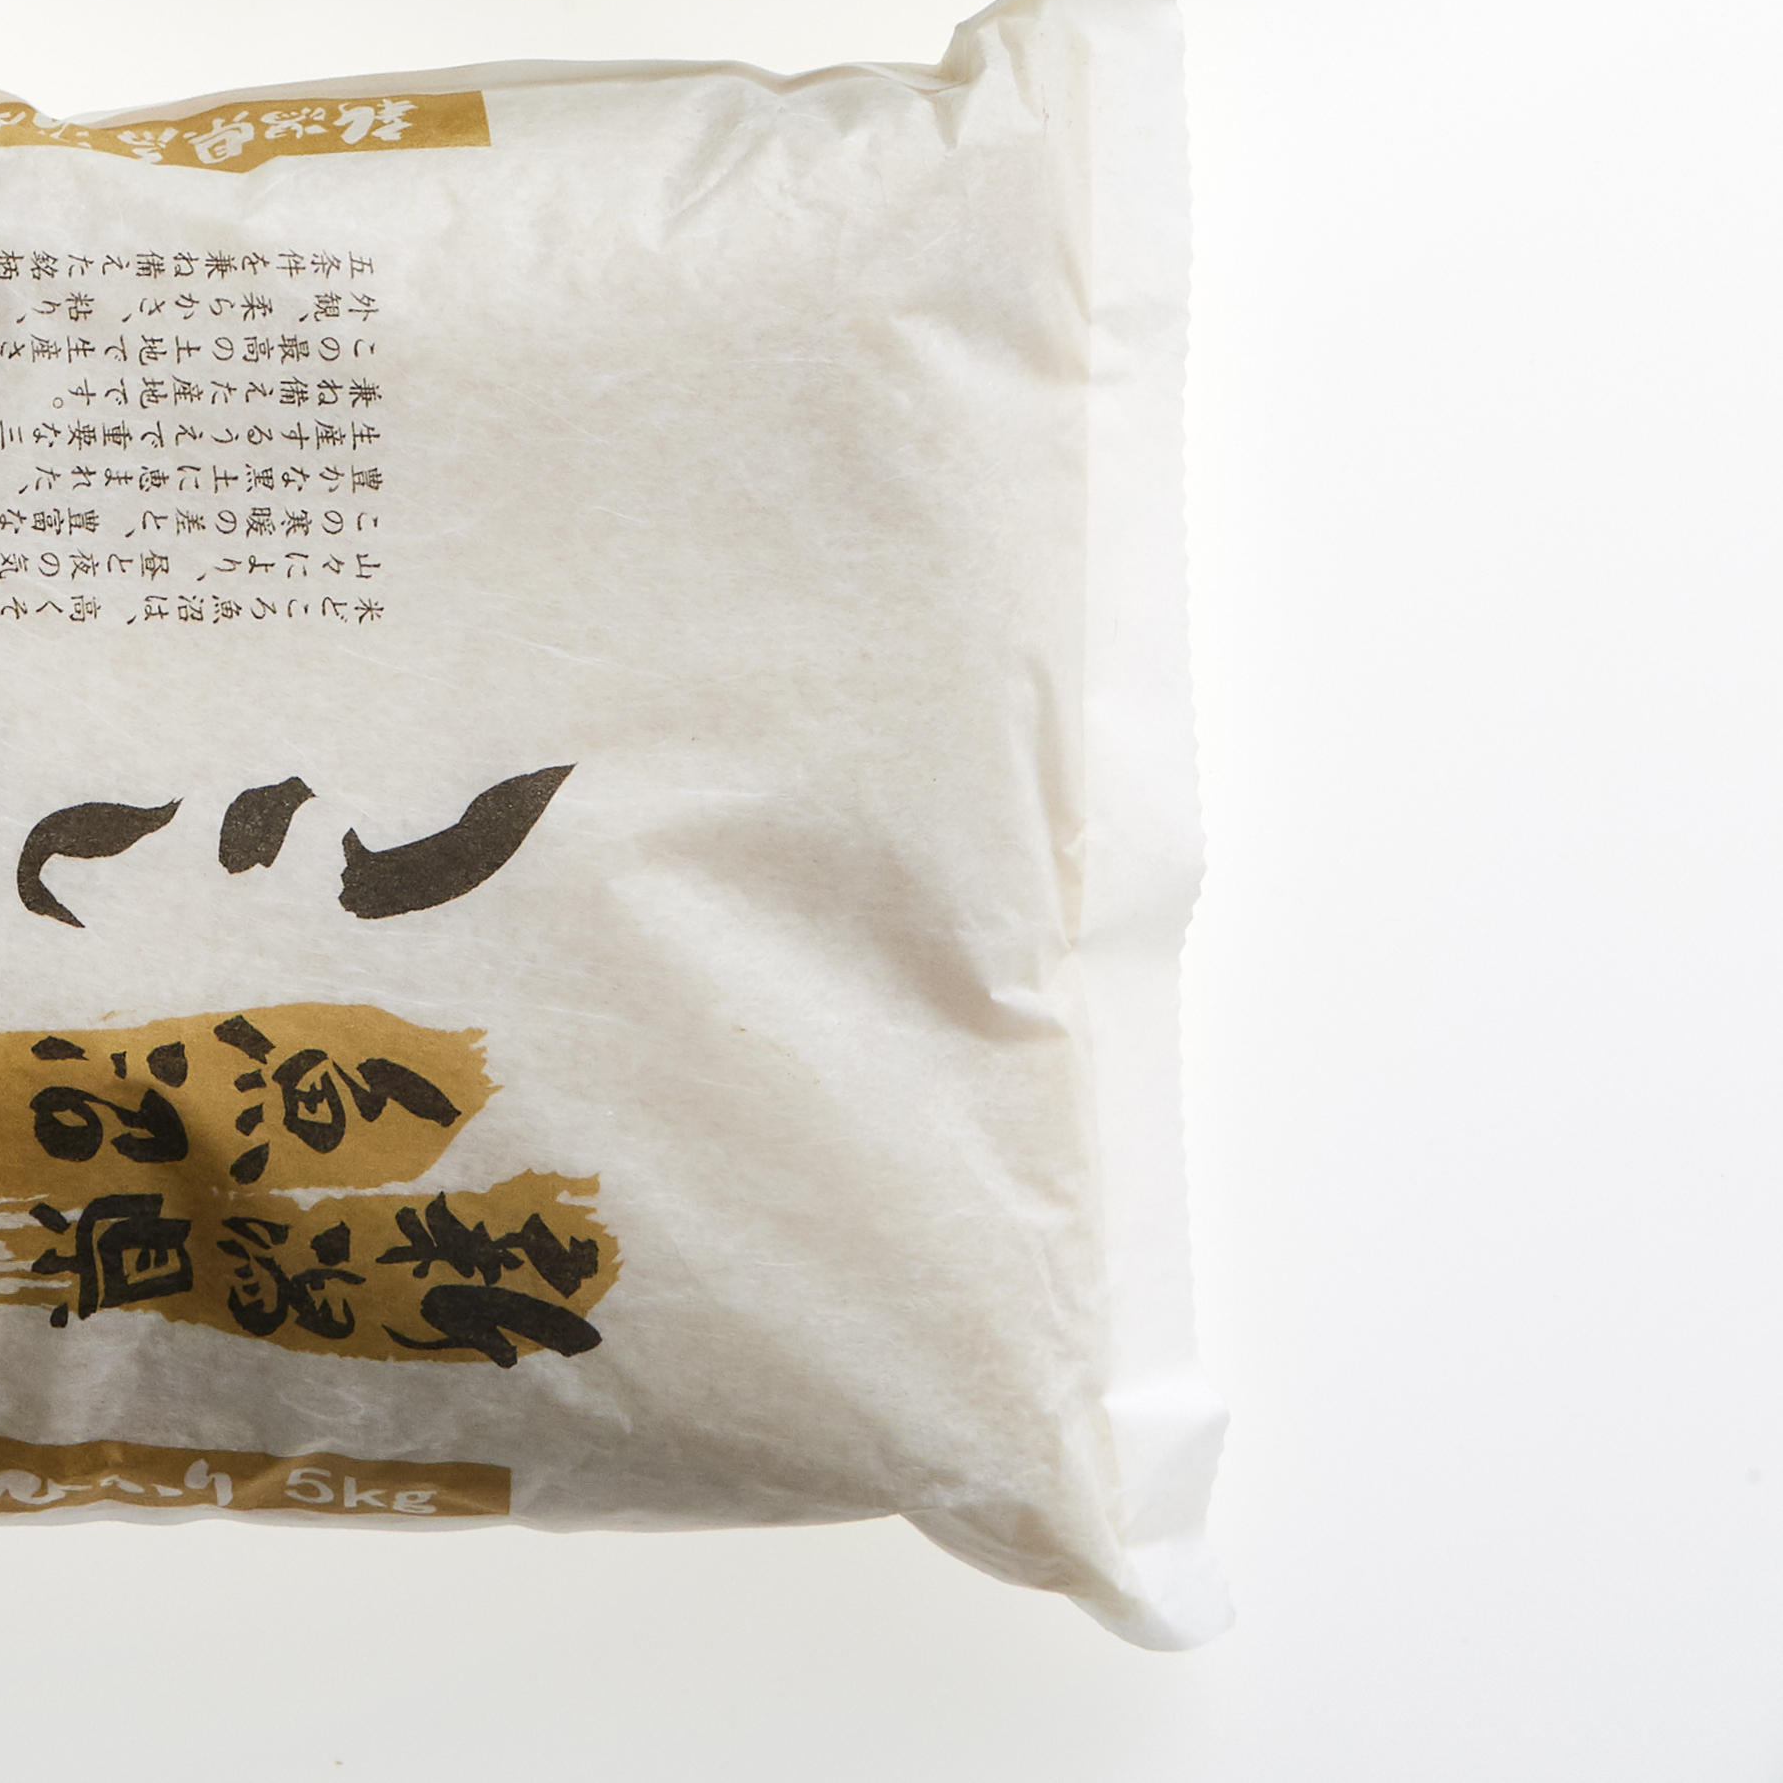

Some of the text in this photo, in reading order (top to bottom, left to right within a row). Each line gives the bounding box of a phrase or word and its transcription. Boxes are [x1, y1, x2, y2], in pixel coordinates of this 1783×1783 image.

[30, 1192, 603, 1368] 新潟県
[283, 1465, 439, 1515] 5kg
